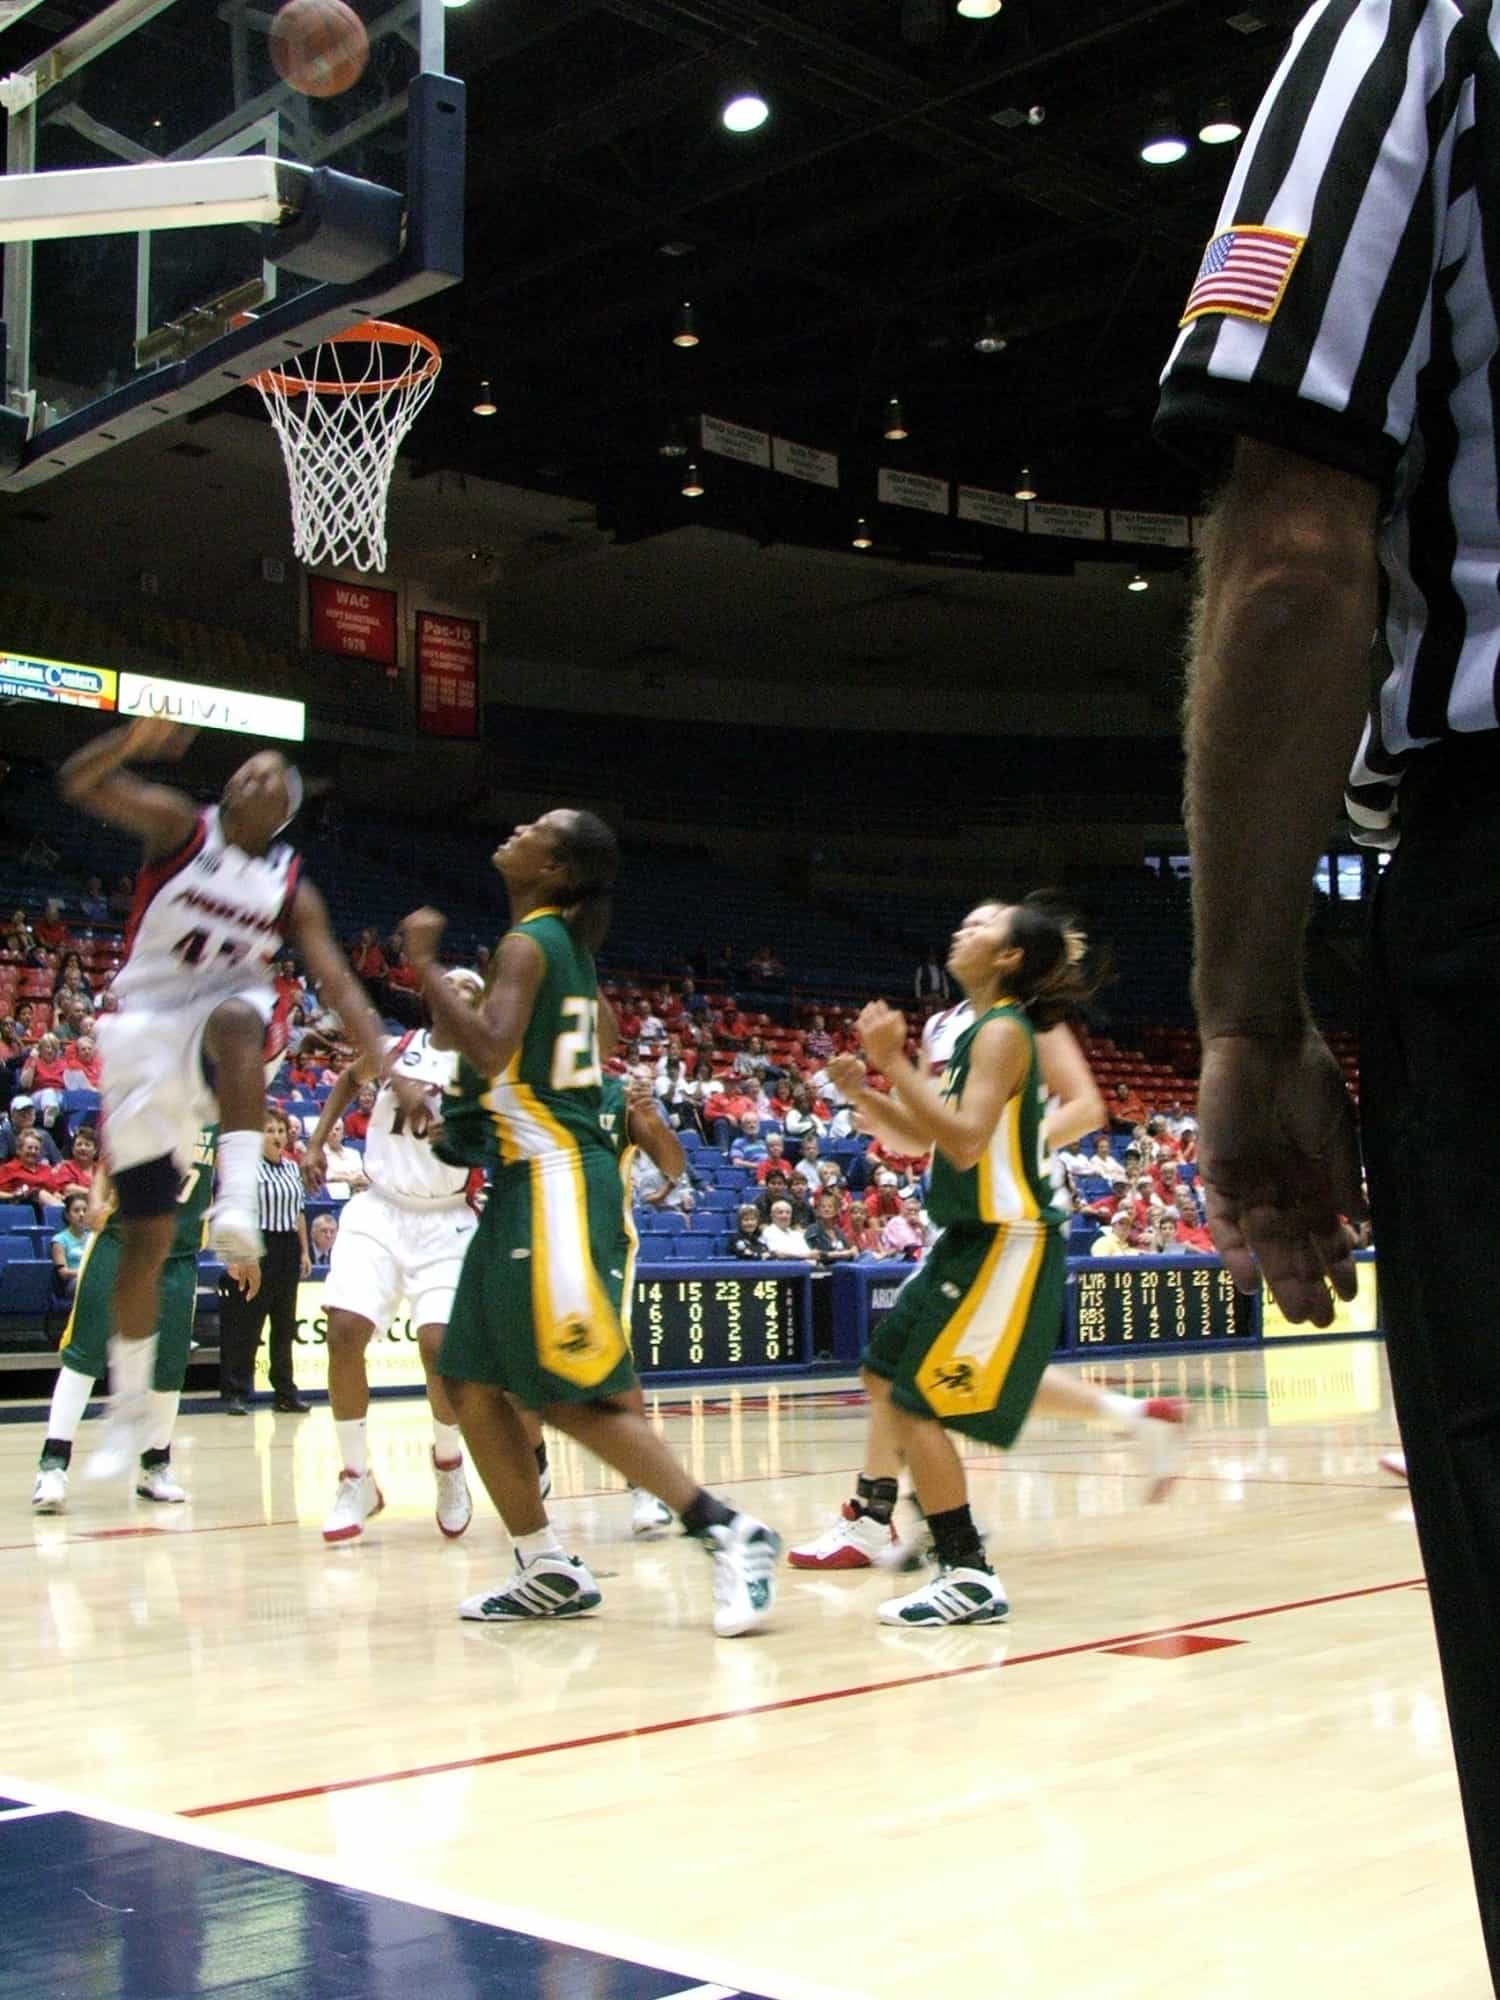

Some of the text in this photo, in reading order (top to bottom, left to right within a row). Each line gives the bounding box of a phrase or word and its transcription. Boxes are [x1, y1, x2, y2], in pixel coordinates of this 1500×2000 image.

[336, 590, 371, 609] WAC
[1115, 1272, 1133, 1289] 10
[1140, 1271, 1159, 1288] 20
[1167, 1271, 1182, 1287] 21
[1192, 1270, 1210, 1286] 22
[1217, 1270, 1234, 1285] 42
[679, 1282, 703, 1302] 15
[715, 1281, 741, 1301] 23
[753, 1281, 778, 1300] 45
[1080, 1286, 1235, 1307] PTS 2 11 3 6 13
[649, 1301, 778, 1323] 6 0 5 4
[1079, 1302, 1235, 1325] RBS 2 4 0 3 4
[649, 1321, 779, 1345] 3 0 2 2
[1079, 1319, 1236, 1343] FLS 2 2 0 2 2
[651, 1341, 779, 1365] 1 0 3 0
